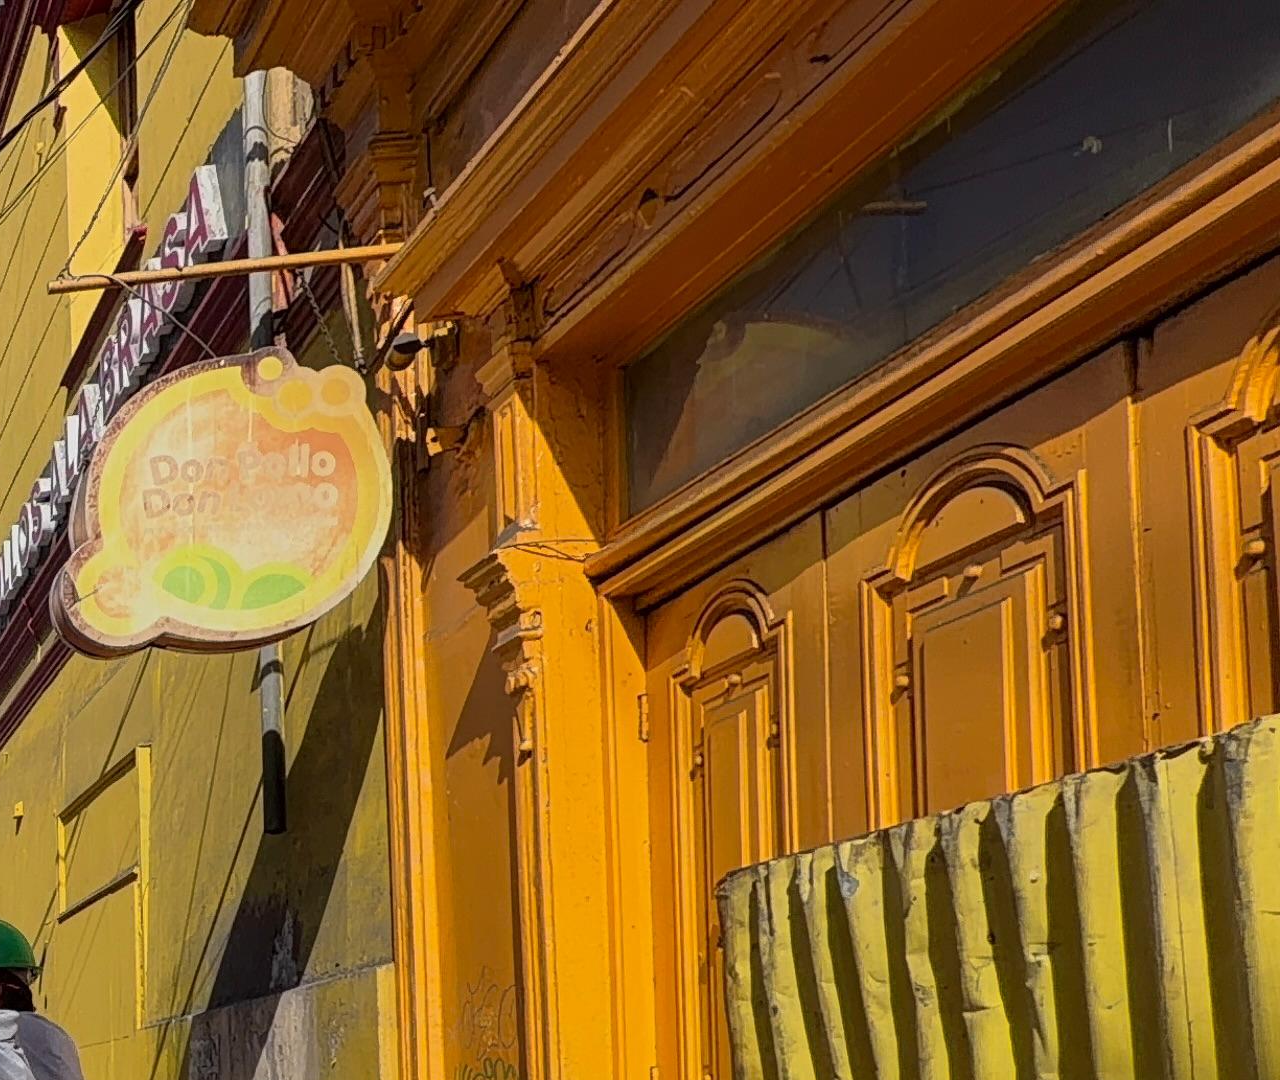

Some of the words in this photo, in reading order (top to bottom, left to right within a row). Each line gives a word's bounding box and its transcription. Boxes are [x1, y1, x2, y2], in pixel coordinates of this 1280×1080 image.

[98, 164, 228, 426] BRASA
[149, 454, 229, 486] Don
[236, 441, 336, 484] Pollo
[142, 487, 222, 519] Don
